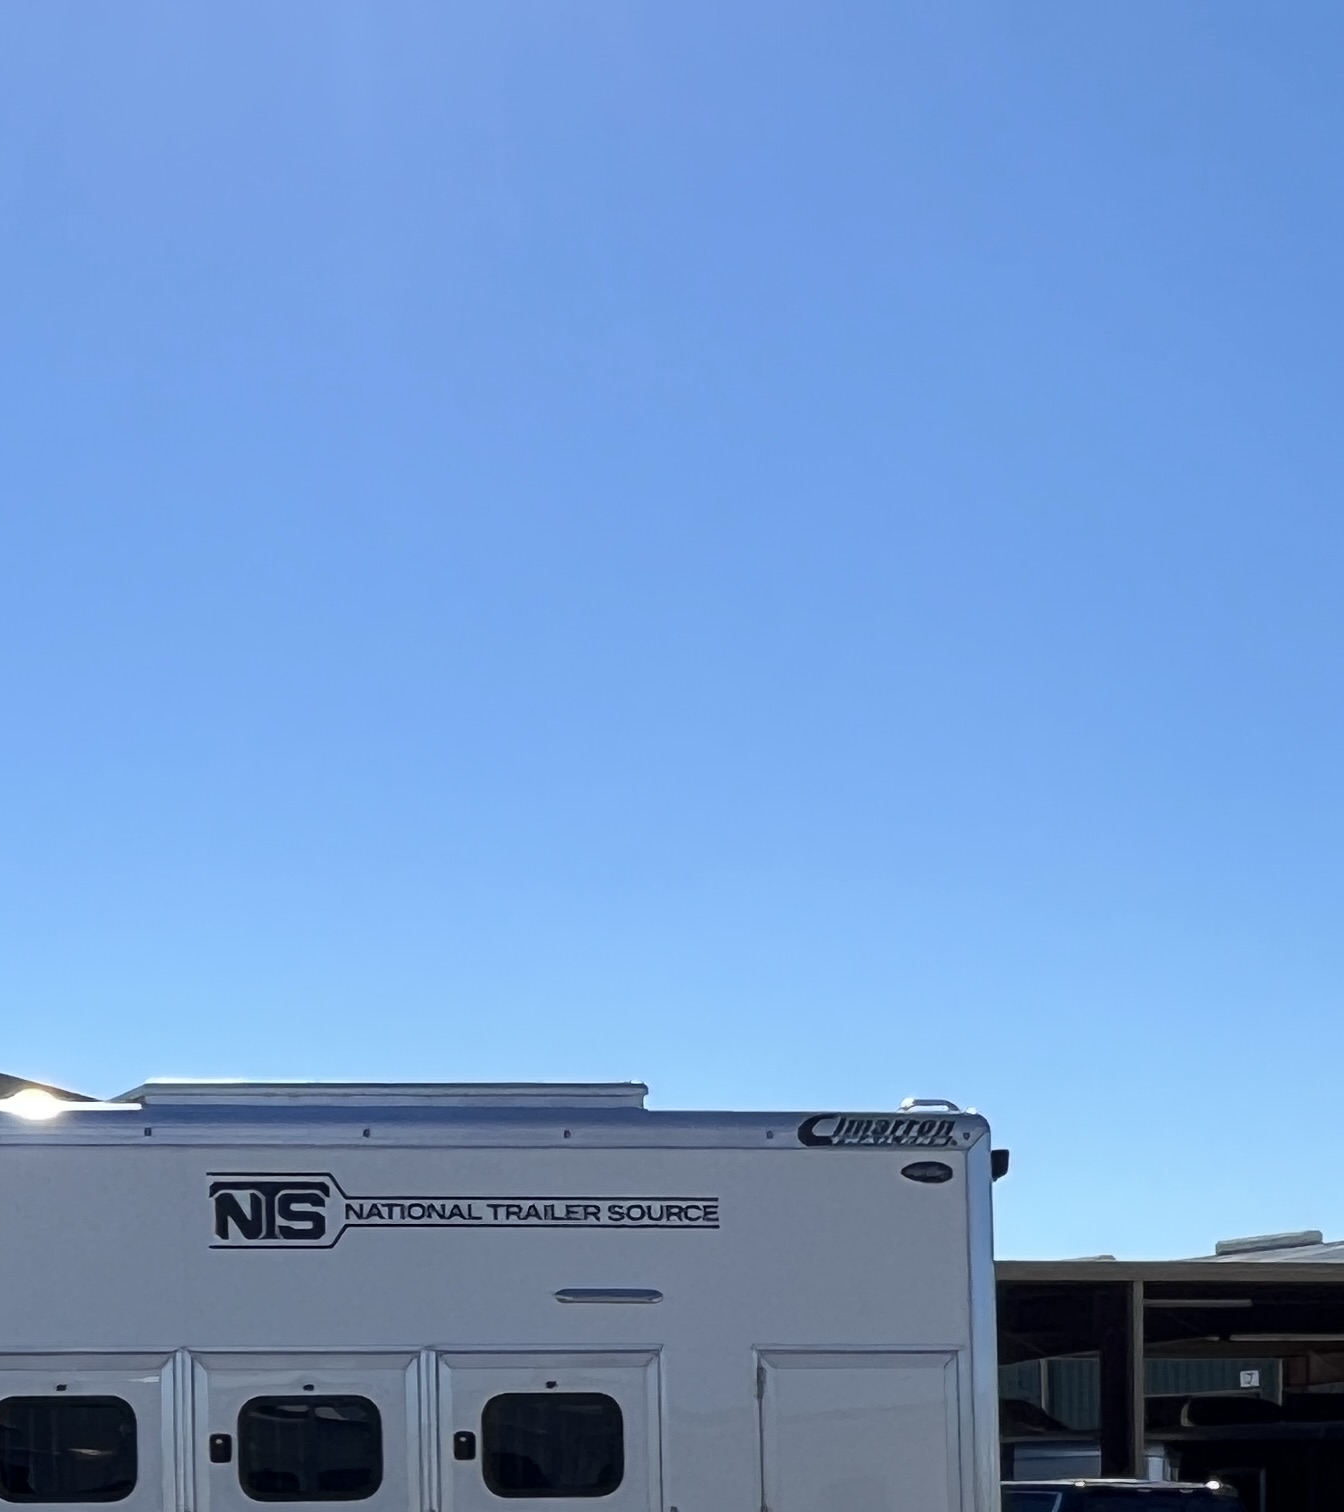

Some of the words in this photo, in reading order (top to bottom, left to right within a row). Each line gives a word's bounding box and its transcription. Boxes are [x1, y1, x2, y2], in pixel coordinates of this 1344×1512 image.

[798, 1113, 956, 1146] Cimarron
[209, 1181, 330, 1240] NTS
[345, 1203, 482, 1220] NATIONAL
[486, 1203, 600, 1221] TRAILER
[608, 1204, 719, 1222] SOURCE
